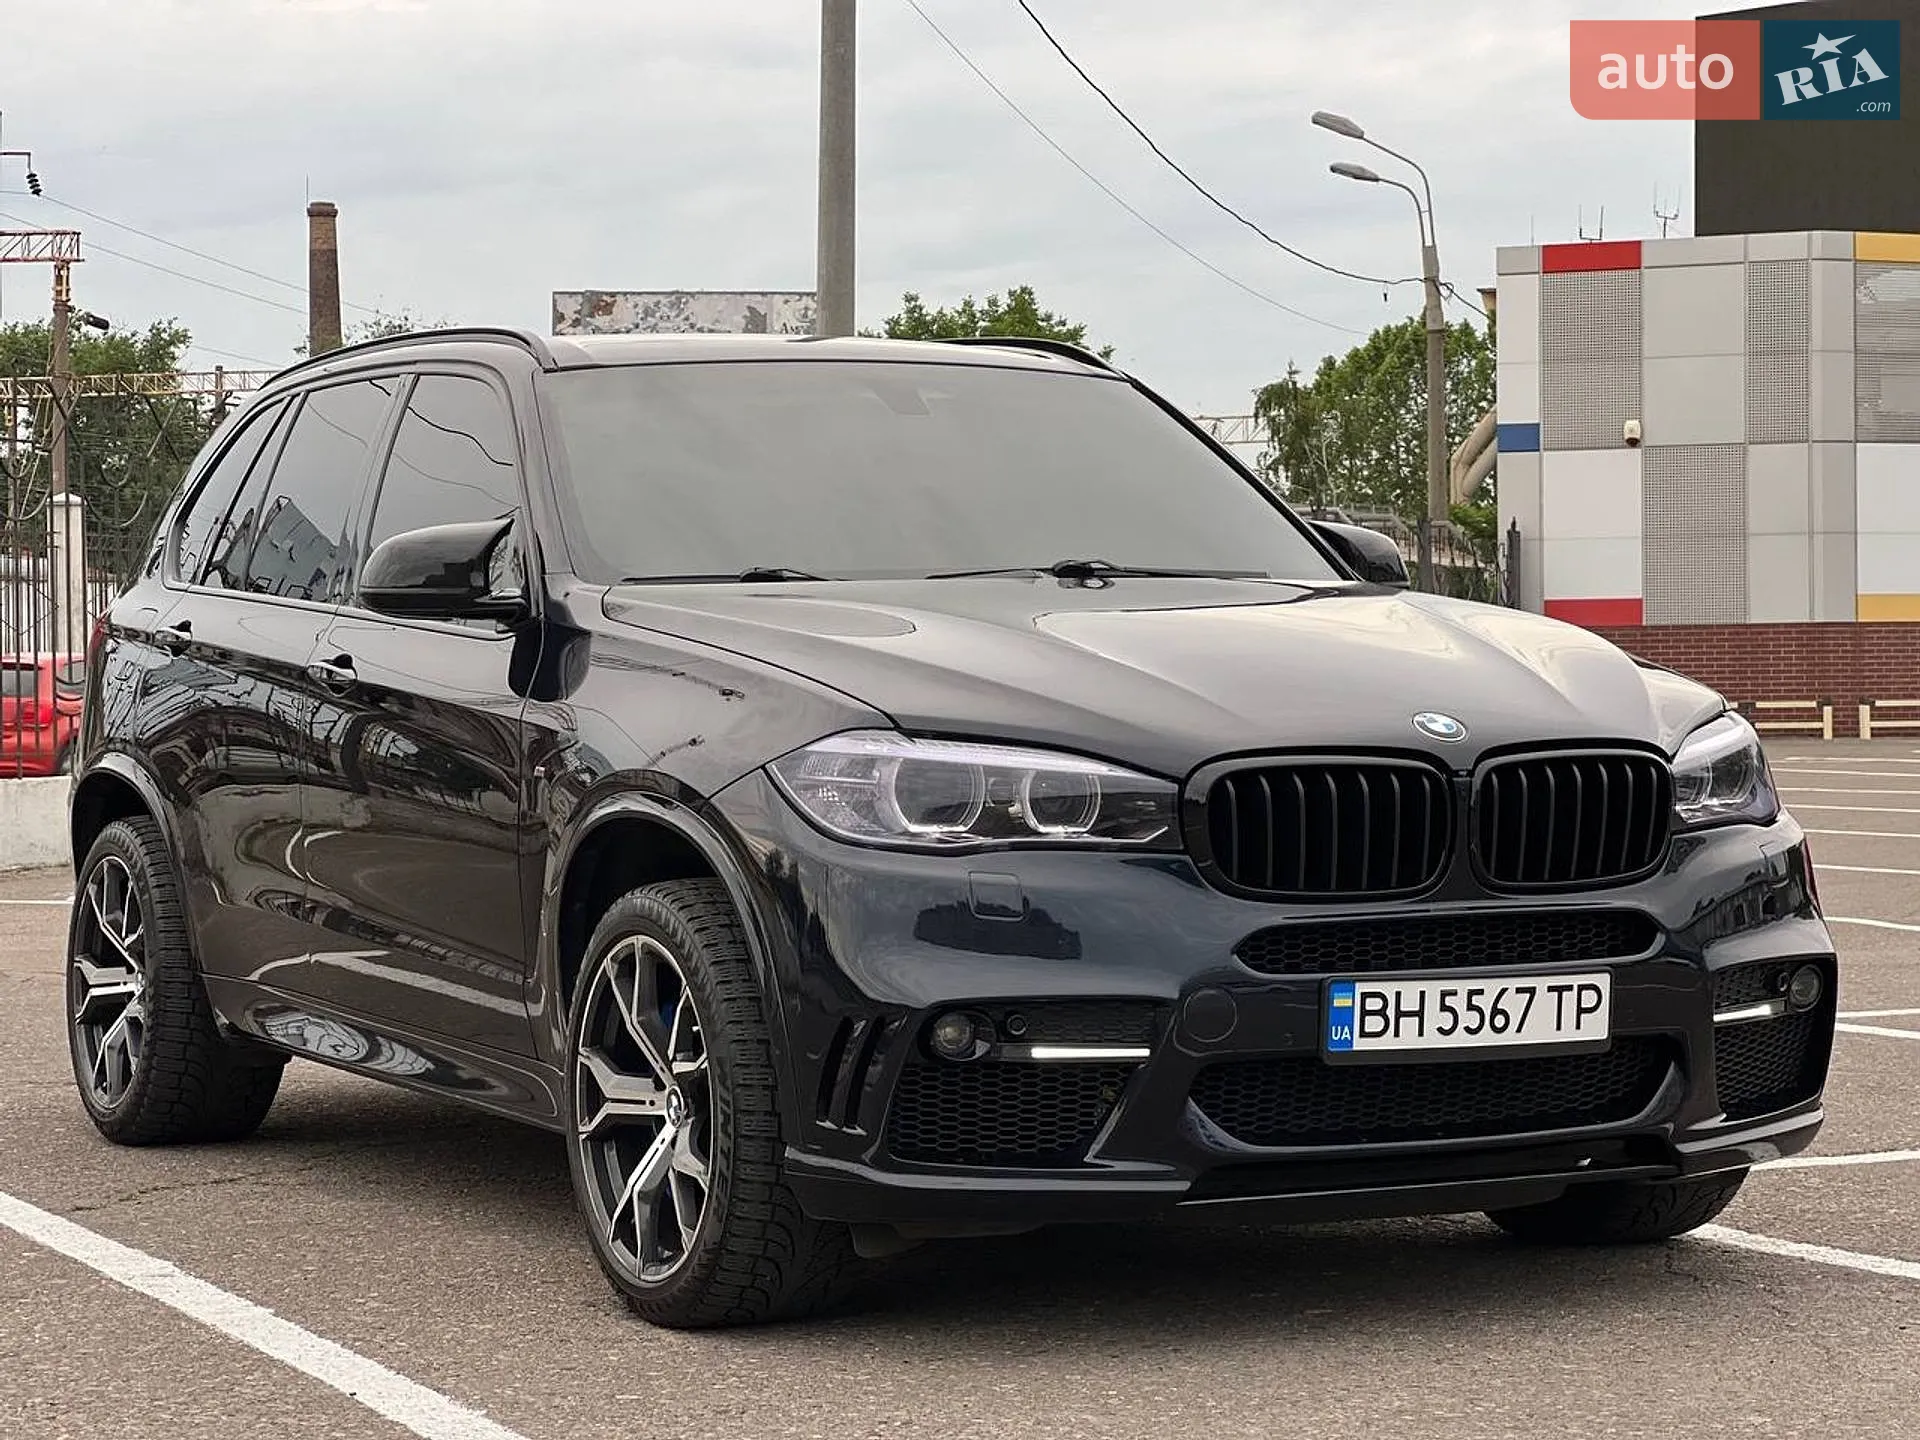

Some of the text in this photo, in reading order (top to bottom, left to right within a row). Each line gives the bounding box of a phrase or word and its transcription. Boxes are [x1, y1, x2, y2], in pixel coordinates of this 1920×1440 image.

[1358, 983, 1604, 1038] BH 5567 TP
[1332, 1025, 1351, 1041] UA
